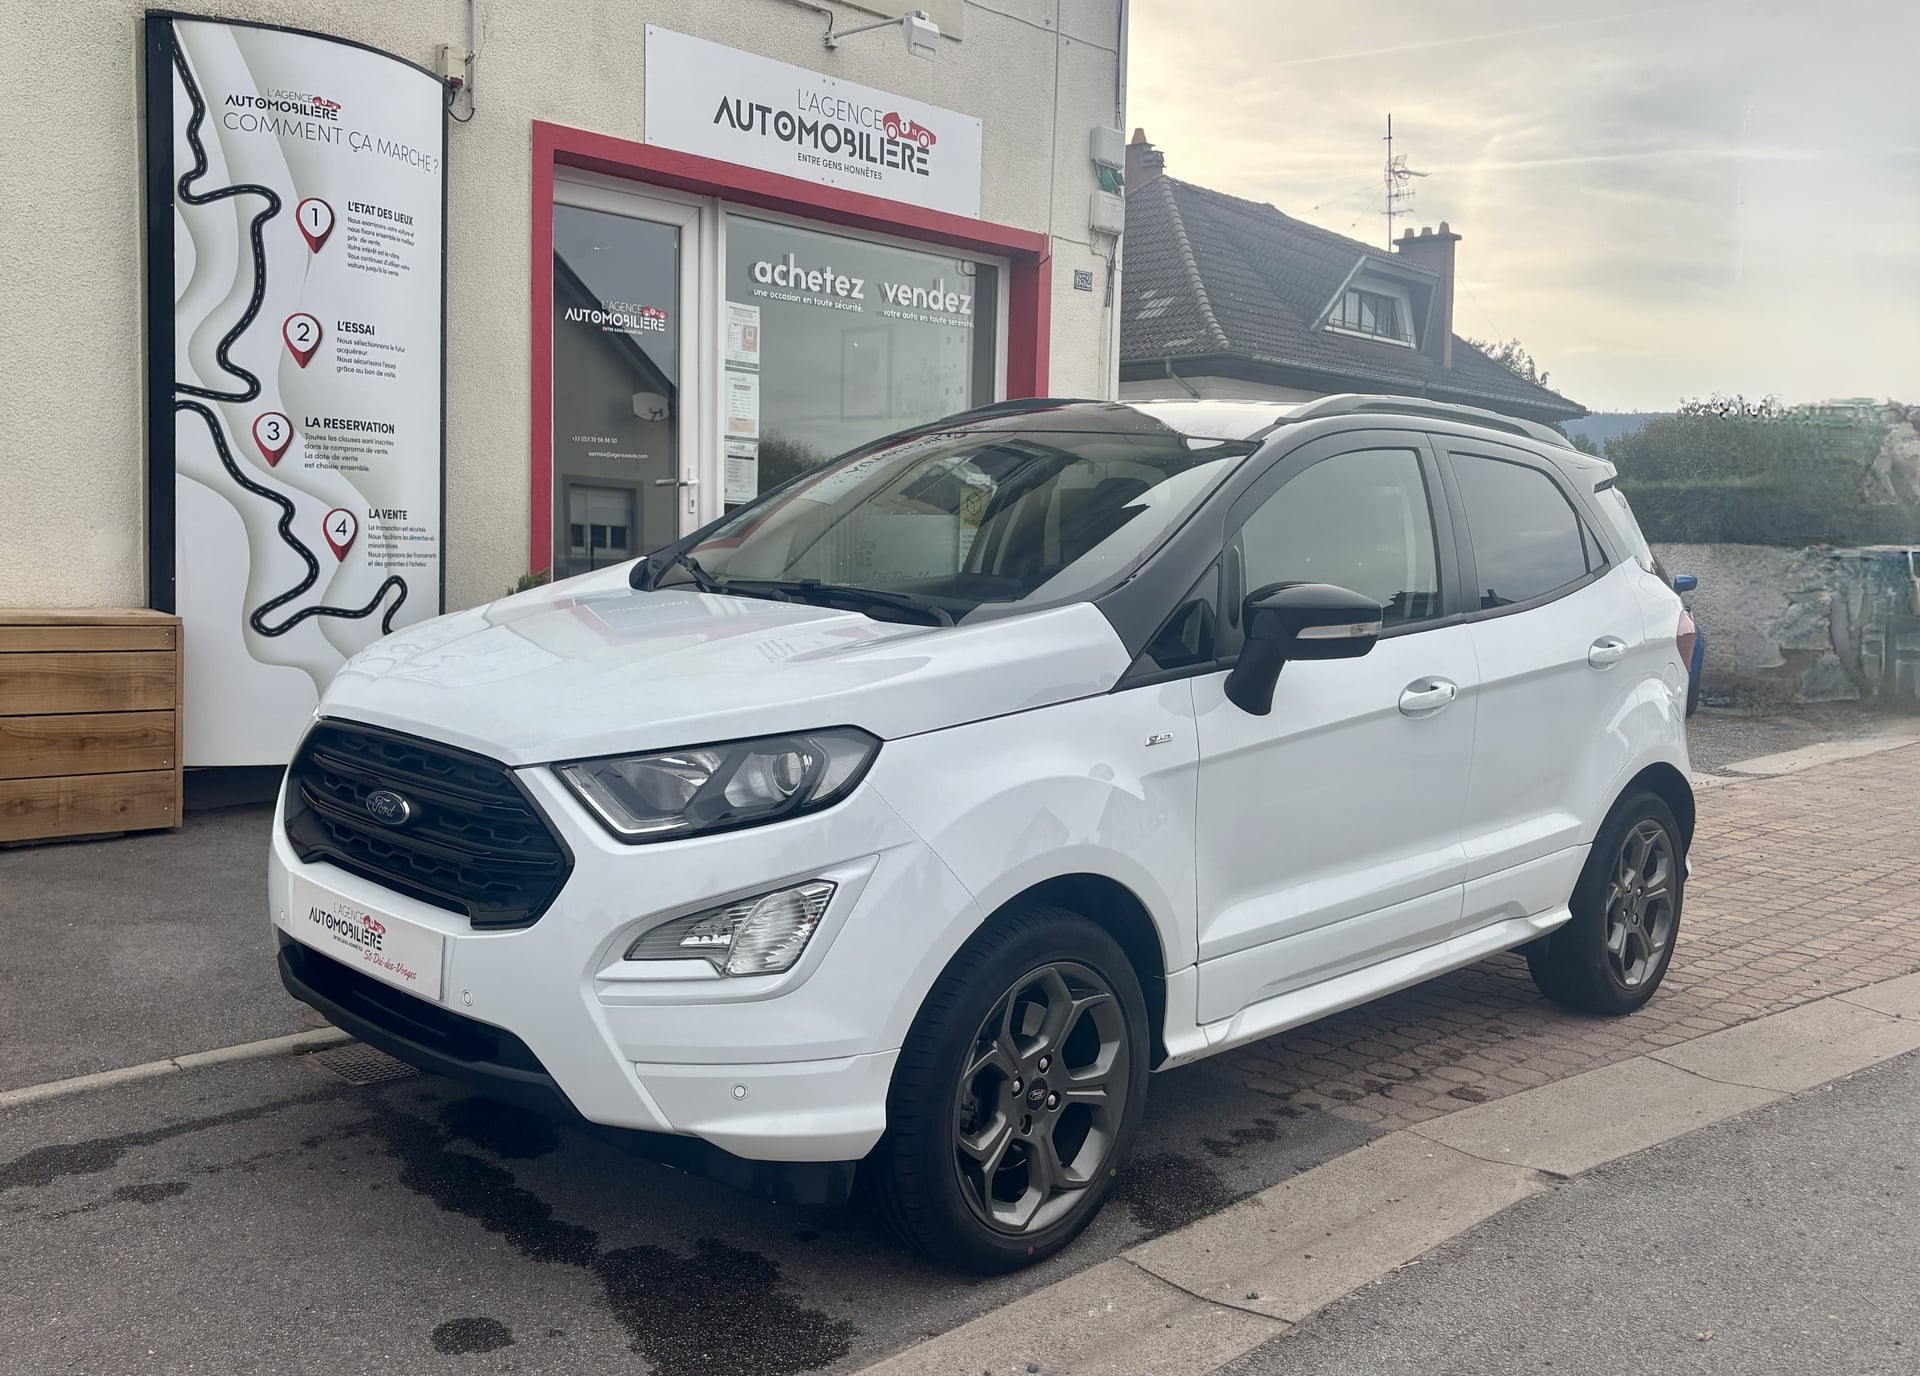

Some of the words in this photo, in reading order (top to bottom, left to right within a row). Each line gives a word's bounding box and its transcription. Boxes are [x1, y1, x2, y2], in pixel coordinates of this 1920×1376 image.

[267, 87, 313, 104] L'AGENCE
[798, 88, 884, 132] L'AGENCE
[224, 112, 343, 145] COMMENT
[348, 131, 372, 152] ÇA
[376, 138, 432, 172] MARCHE
[433, 158, 439, 174] ?
[798, 152, 821, 166] ENTRE
[822, 158, 842, 171] GENS
[844, 163, 882, 180] HONNÊTES
[311, 207, 318, 227] 1
[348, 200, 376, 216] L'ETAT
[377, 207, 392, 220] DES
[394, 212, 414, 226] LIEUX
[348, 216, 360, 224] Nous
[362, 220, 386, 230] examinons
[347, 234, 358, 242] prix
[347, 243, 361, 252] Votre
[347, 252, 360, 260] Vous
[754, 252, 864, 300] achetez
[1076, 274, 1091, 288] 652
[754, 288, 768, 298] une
[770, 291, 800, 303] occasion
[802, 296, 812, 305] en
[813, 296, 833, 308] toute
[834, 300, 864, 312] sécurité.
[884, 278, 972, 315] vendez
[602, 300, 642, 314] L'AGENCE
[883, 310, 900, 318] votre
[902, 311, 918, 320] auto
[919, 314, 928, 322] en
[929, 314, 947, 326] toute
[297, 322, 310, 342] 2
[337, 320, 375, 336] L'ESSAI
[336, 337, 352, 345] Nous
[354, 339, 390, 350] sélectionnons
[336, 356, 352, 364] Nous
[354, 358, 382, 368] sécurisons
[336, 365, 354, 374] grâce
[364, 368, 375, 376] bon
[267, 422, 280, 440] 3
[306, 416, 320, 428] LA
[324, 418, 394, 434] RESERVATION
[305, 433, 326, 441] Toutes
[338, 436, 360, 444] clauses
[374, 438, 394, 446] inscrites
[330, 446, 364, 454] compromis
[316, 462, 338, 470] choisie
[368, 508, 380, 518] LA
[382, 509, 408, 520] VENTE
[335, 518, 347, 536] 4
[372, 796, 396, 817] Ford
[334, 902, 364, 924] L'AGENCE
